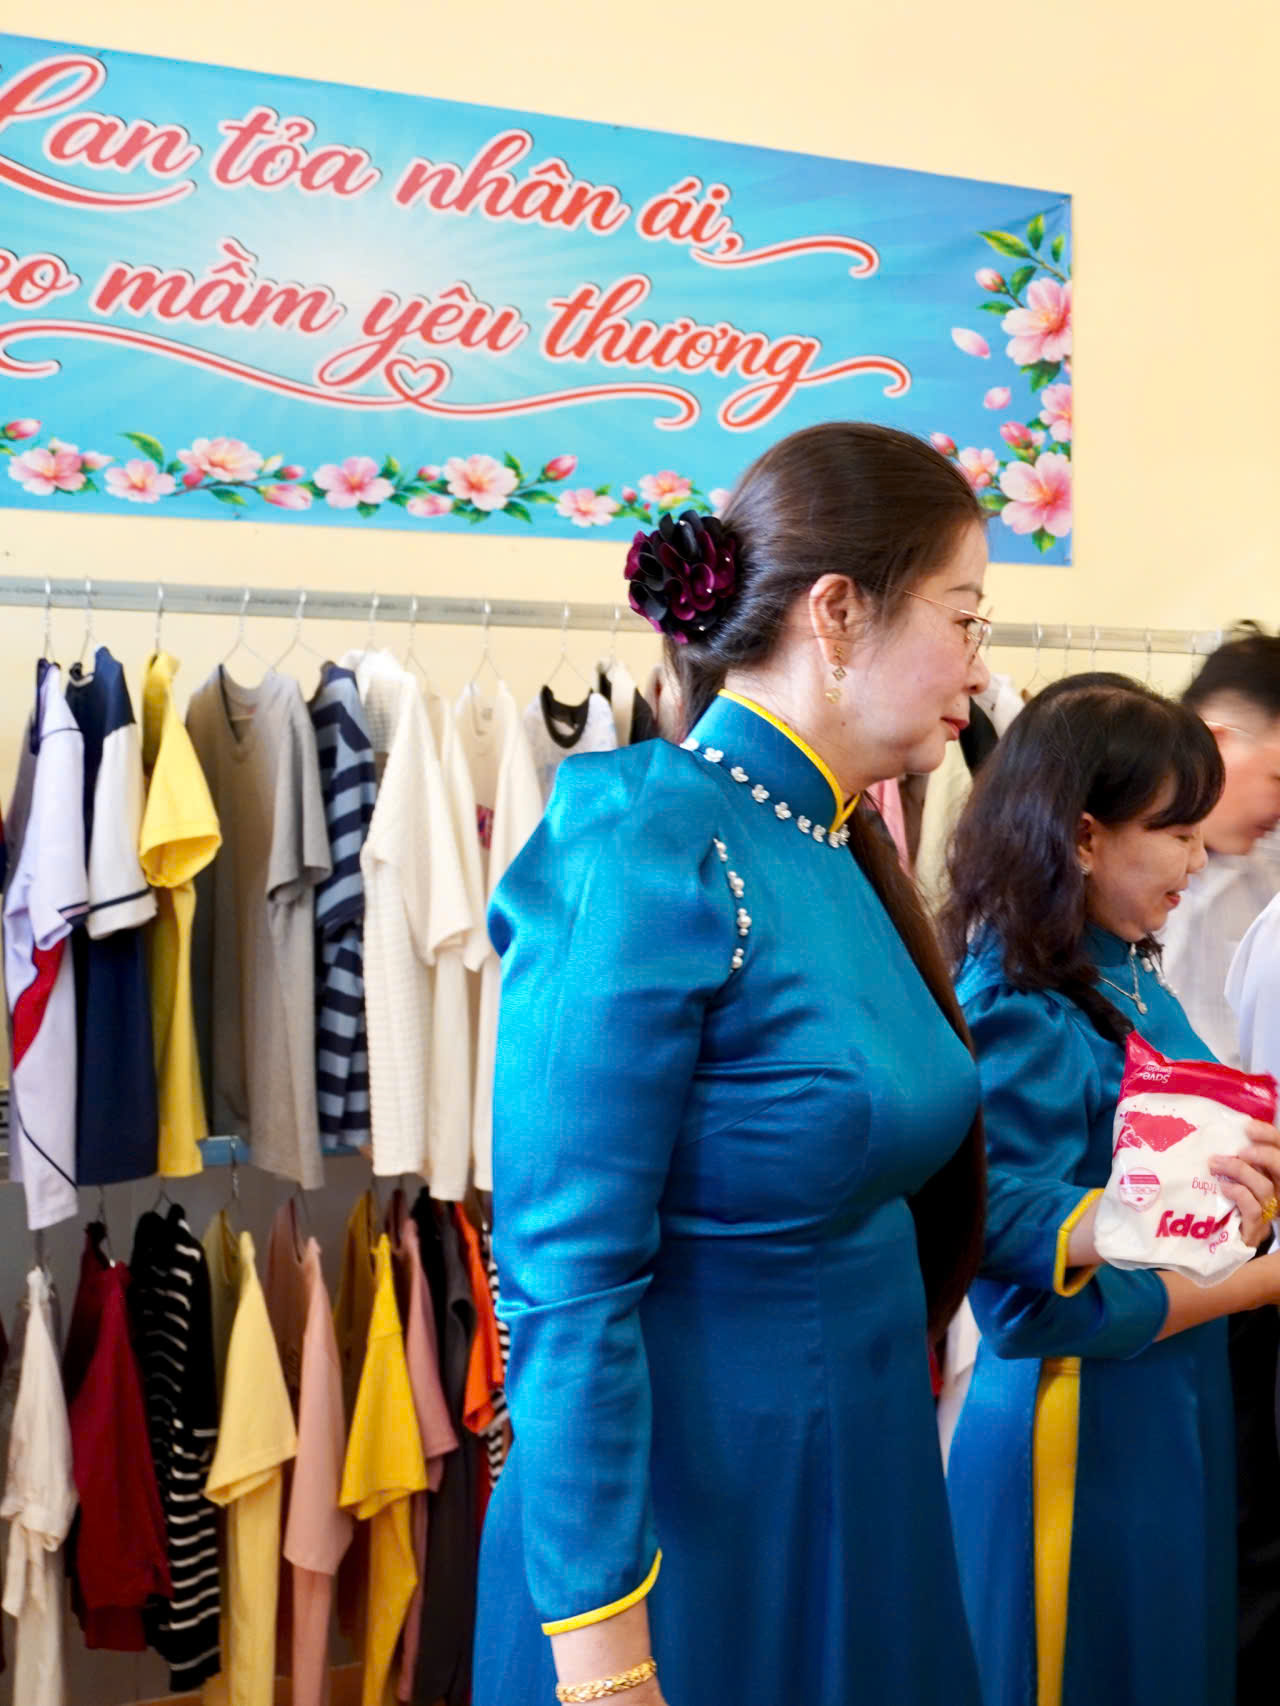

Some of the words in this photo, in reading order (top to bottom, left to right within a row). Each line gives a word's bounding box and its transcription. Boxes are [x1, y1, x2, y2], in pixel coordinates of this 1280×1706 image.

[211, 107, 382, 196] tỏa
[396, 131, 630, 234] nhân
[637, 177, 744, 254] ái,
[91, 237, 346, 334] mầm
[319, 282, 530, 388] yêu
[545, 273, 828, 431] thương
